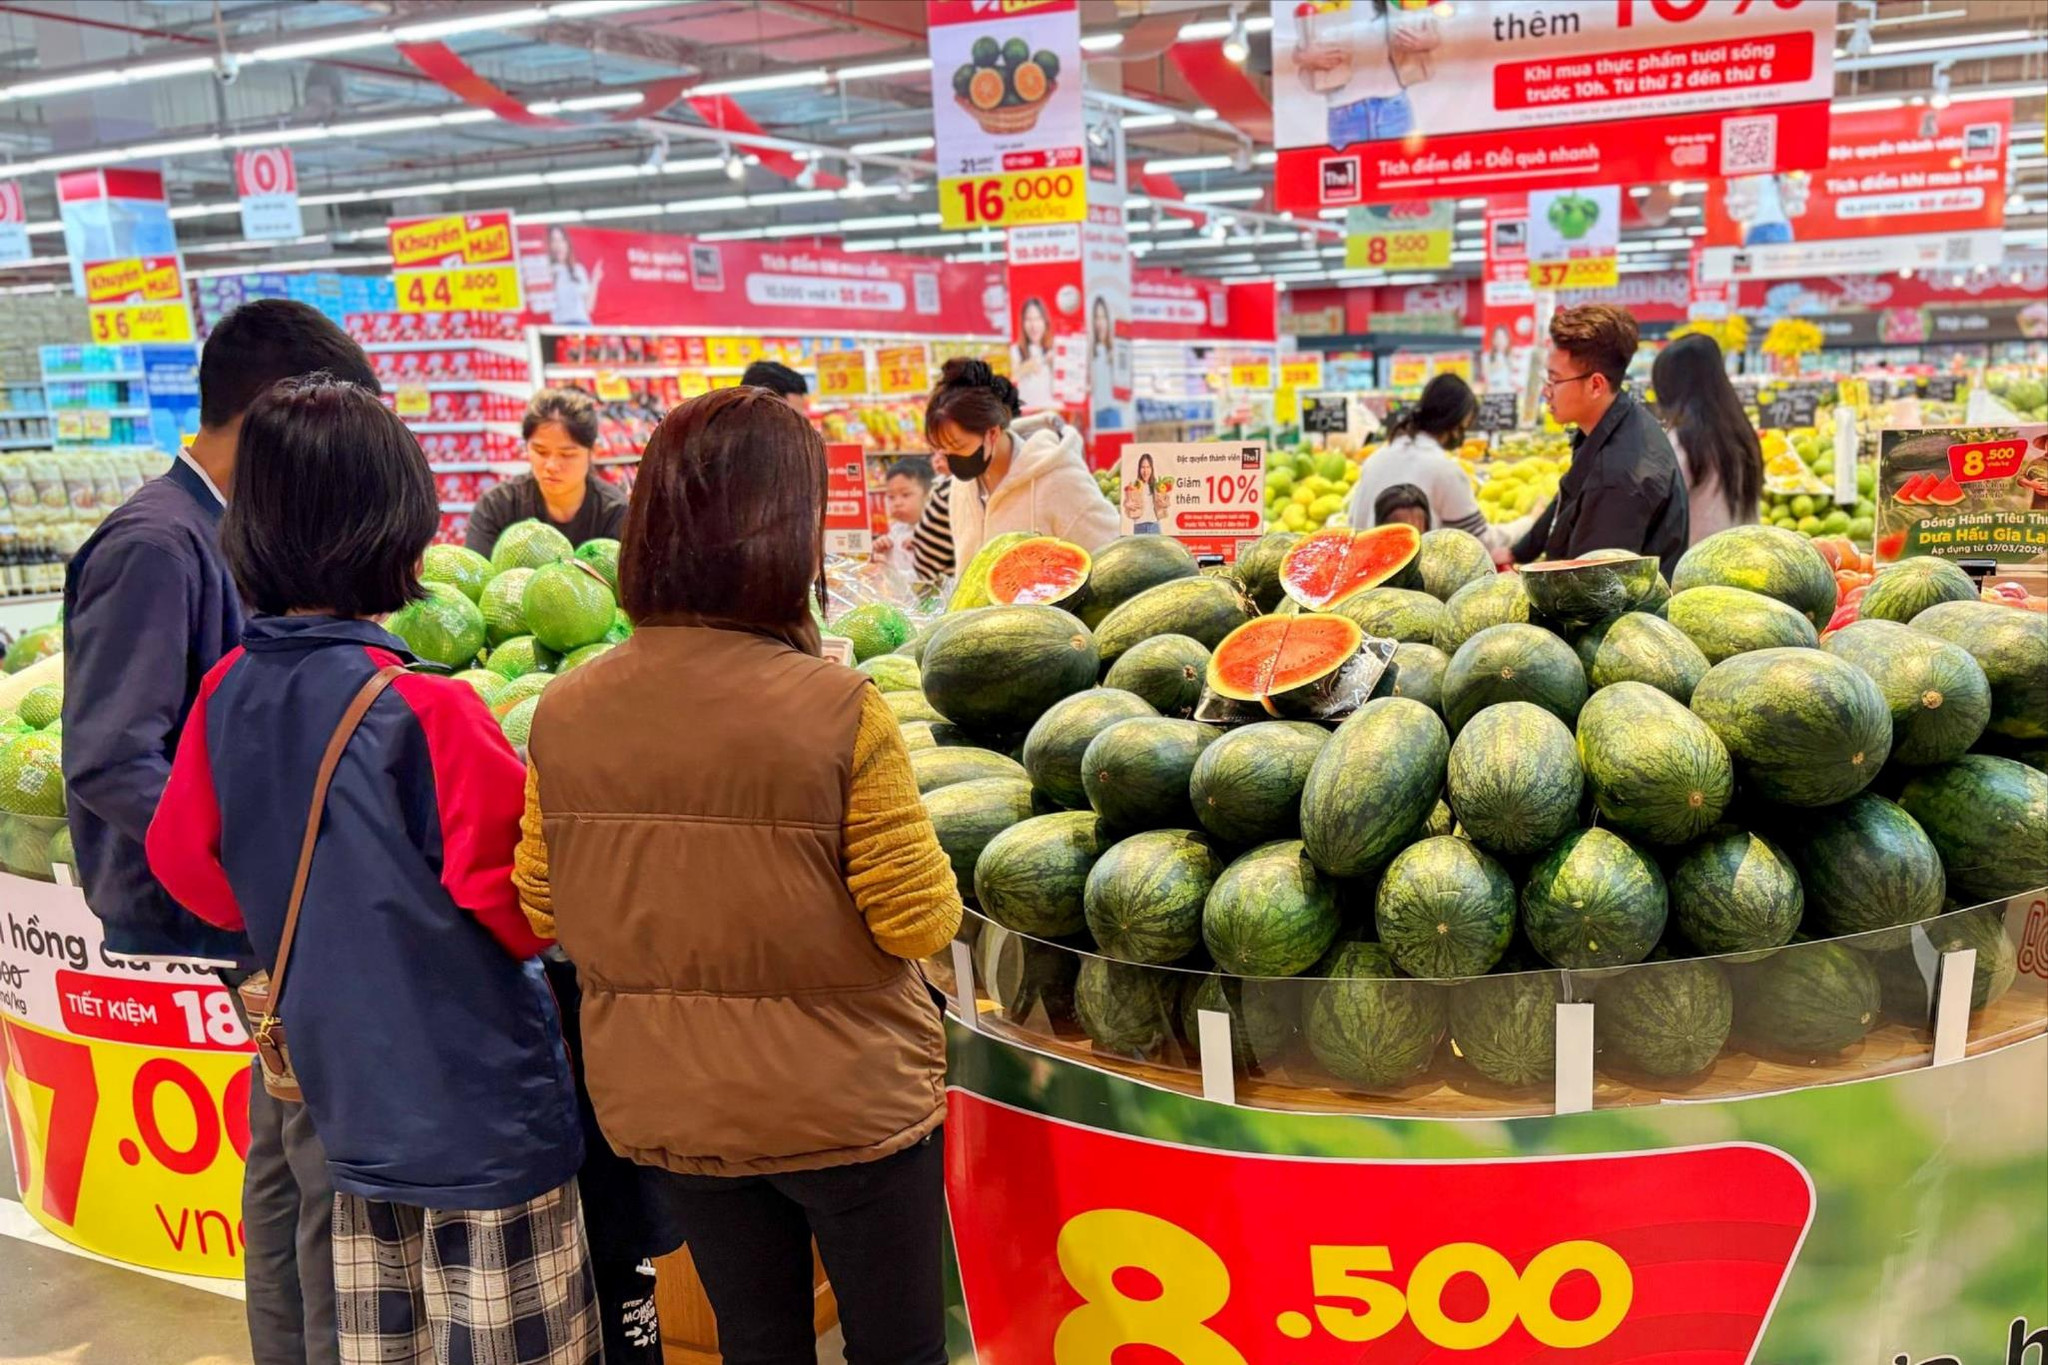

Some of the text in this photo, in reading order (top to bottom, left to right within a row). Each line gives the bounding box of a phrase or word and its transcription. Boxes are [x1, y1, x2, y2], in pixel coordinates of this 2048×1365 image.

[1493, 11, 1580, 42] thêm
[1524, 66, 1552, 82] Khi
[1556, 65, 1593, 79] mua
[1596, 59, 1634, 78] thực
[1731, 41, 1775, 62] sống
[1575, 78, 1609, 98] 10h.
[1671, 72, 1683, 89] 2
[1759, 63, 1772, 80] 6
[1377, 159, 1410, 176] Tích
[1412, 153, 1450, 174] điểm
[1452, 151, 1472, 171] dễ
[1485, 147, 1513, 169] Đổi
[1516, 150, 1547, 171] quà
[1549, 146, 1599, 164] nhanh
[1176, 455, 1188, 463] Đặc
[1176, 474, 1259, 504] Giảm 10%
[1176, 494, 1201, 504] thêm
[1919, 531, 1952, 544] Dưa
[1956, 526, 1989, 542] Hấu
[1993, 528, 2021, 542] Gia
[1920, 516, 1956, 529] Đồng
[1959, 514, 1993, 525] Hành
[1996, 513, 2025, 524] Tiêu
[1931, 545, 1945, 555] Áp
[1947, 544, 1971, 554] dụng
[1973, 543, 1984, 552] từ
[8, 912, 89, 970] hồng
[65, 988, 158, 1027] TIẾT KIỆM
[154, 1202, 246, 1258] vn
